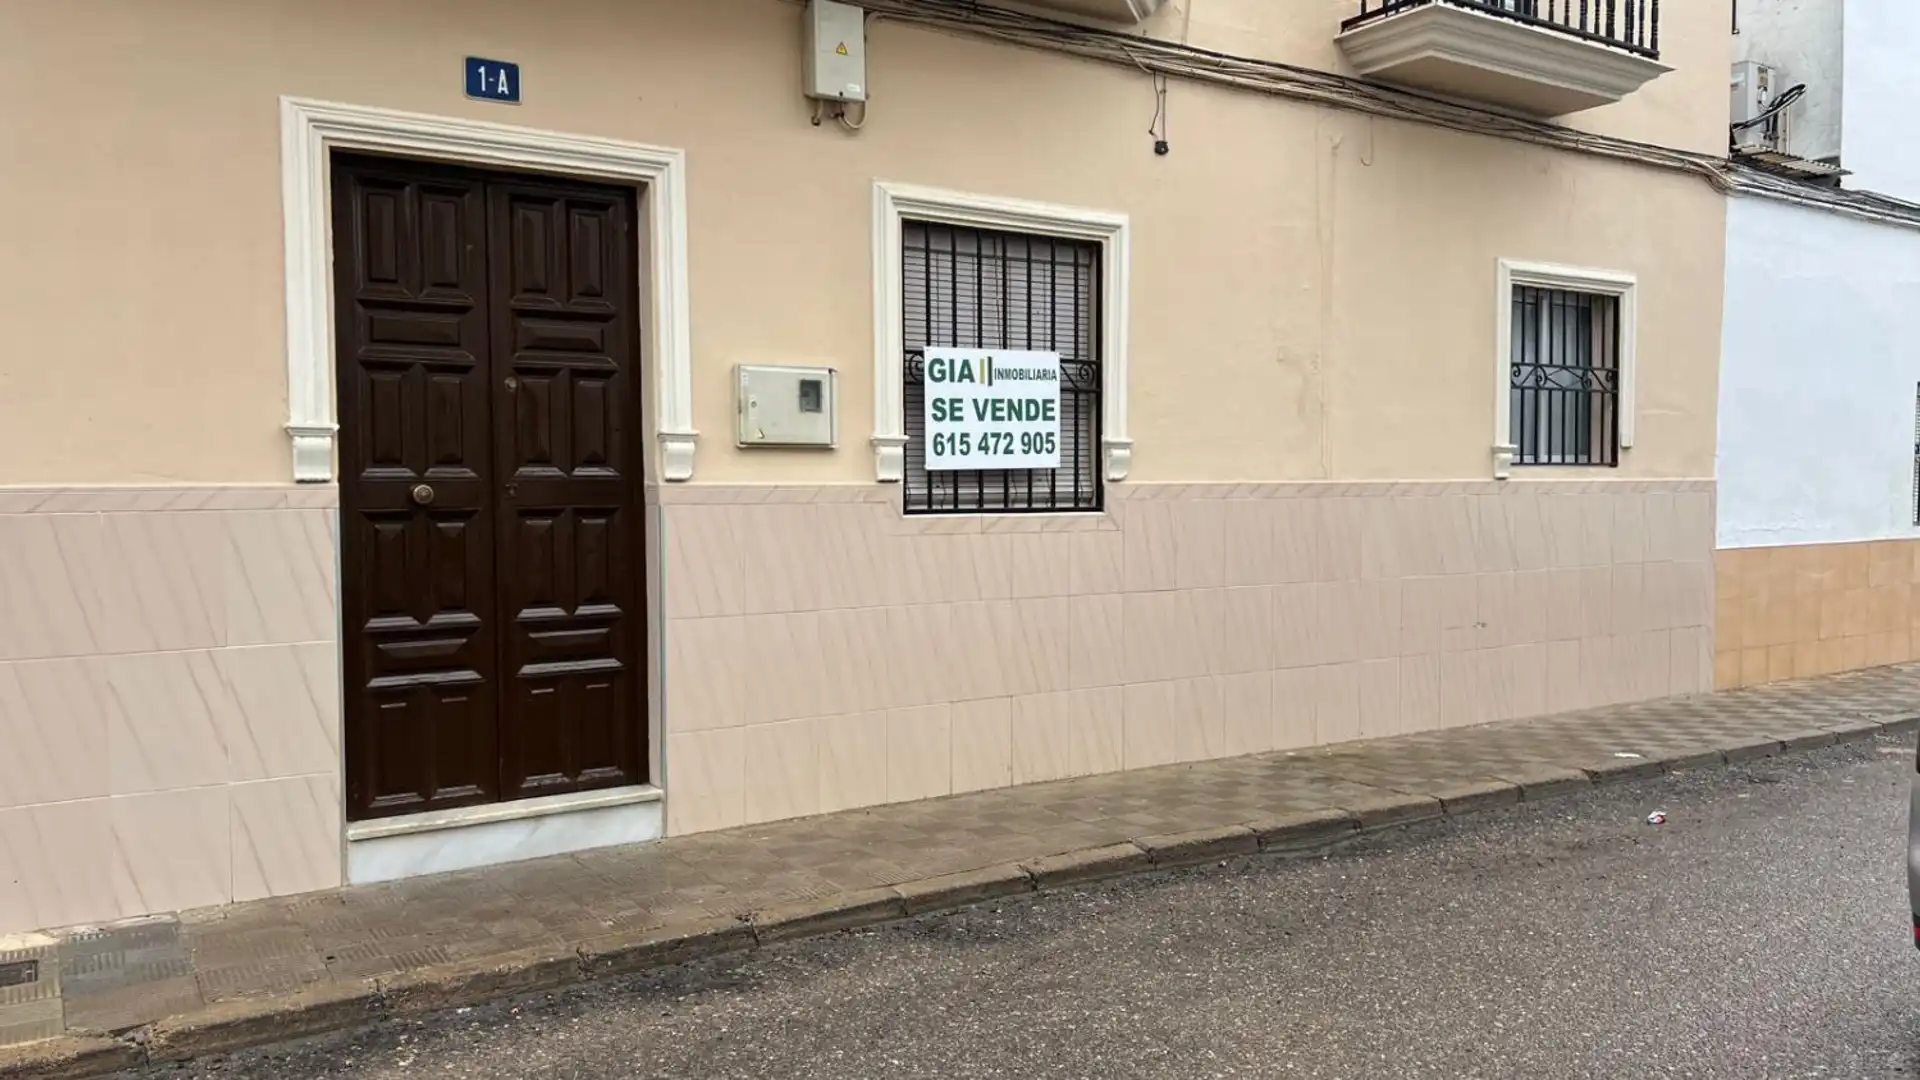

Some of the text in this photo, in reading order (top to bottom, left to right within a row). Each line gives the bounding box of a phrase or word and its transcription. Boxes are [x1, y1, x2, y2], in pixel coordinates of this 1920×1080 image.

[928, 357, 1057, 383] GIA INMOBILIARIA
[931, 397, 1056, 422] SE VENDE
[933, 431, 1056, 456] 615 472 905
